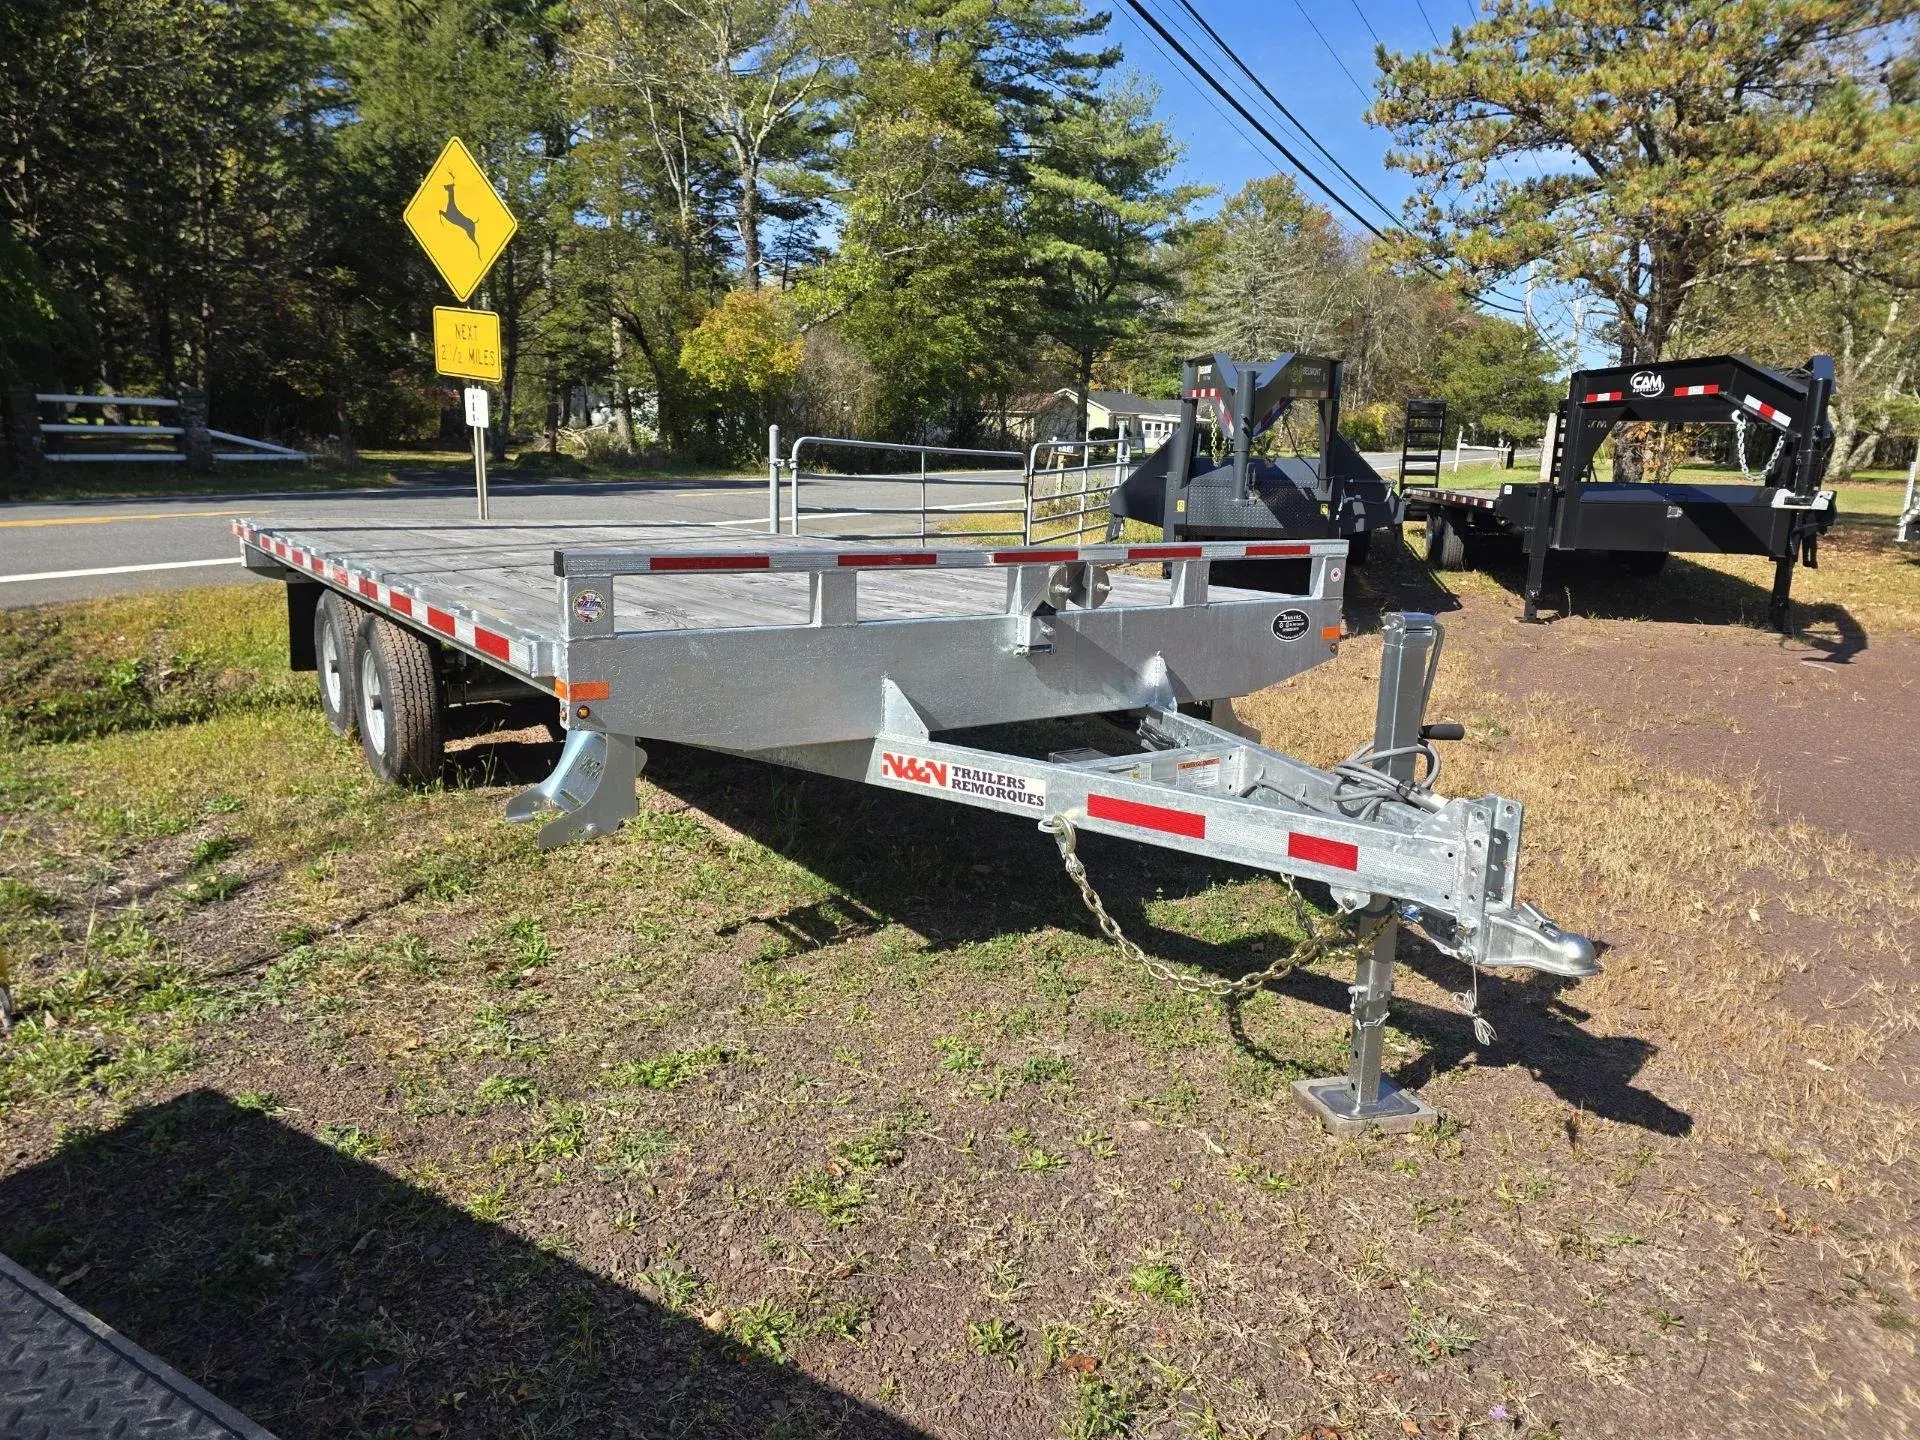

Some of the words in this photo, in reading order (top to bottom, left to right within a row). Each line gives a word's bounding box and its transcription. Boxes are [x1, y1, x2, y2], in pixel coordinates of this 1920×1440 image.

[455, 323, 478, 341] NEXT
[468, 347, 496, 367] MILES
[1633, 374, 1662, 389] CAM
[883, 752, 947, 787] N&N
[952, 766, 1026, 790] TRAILERS
[952, 778, 1045, 807] REMORQUES
